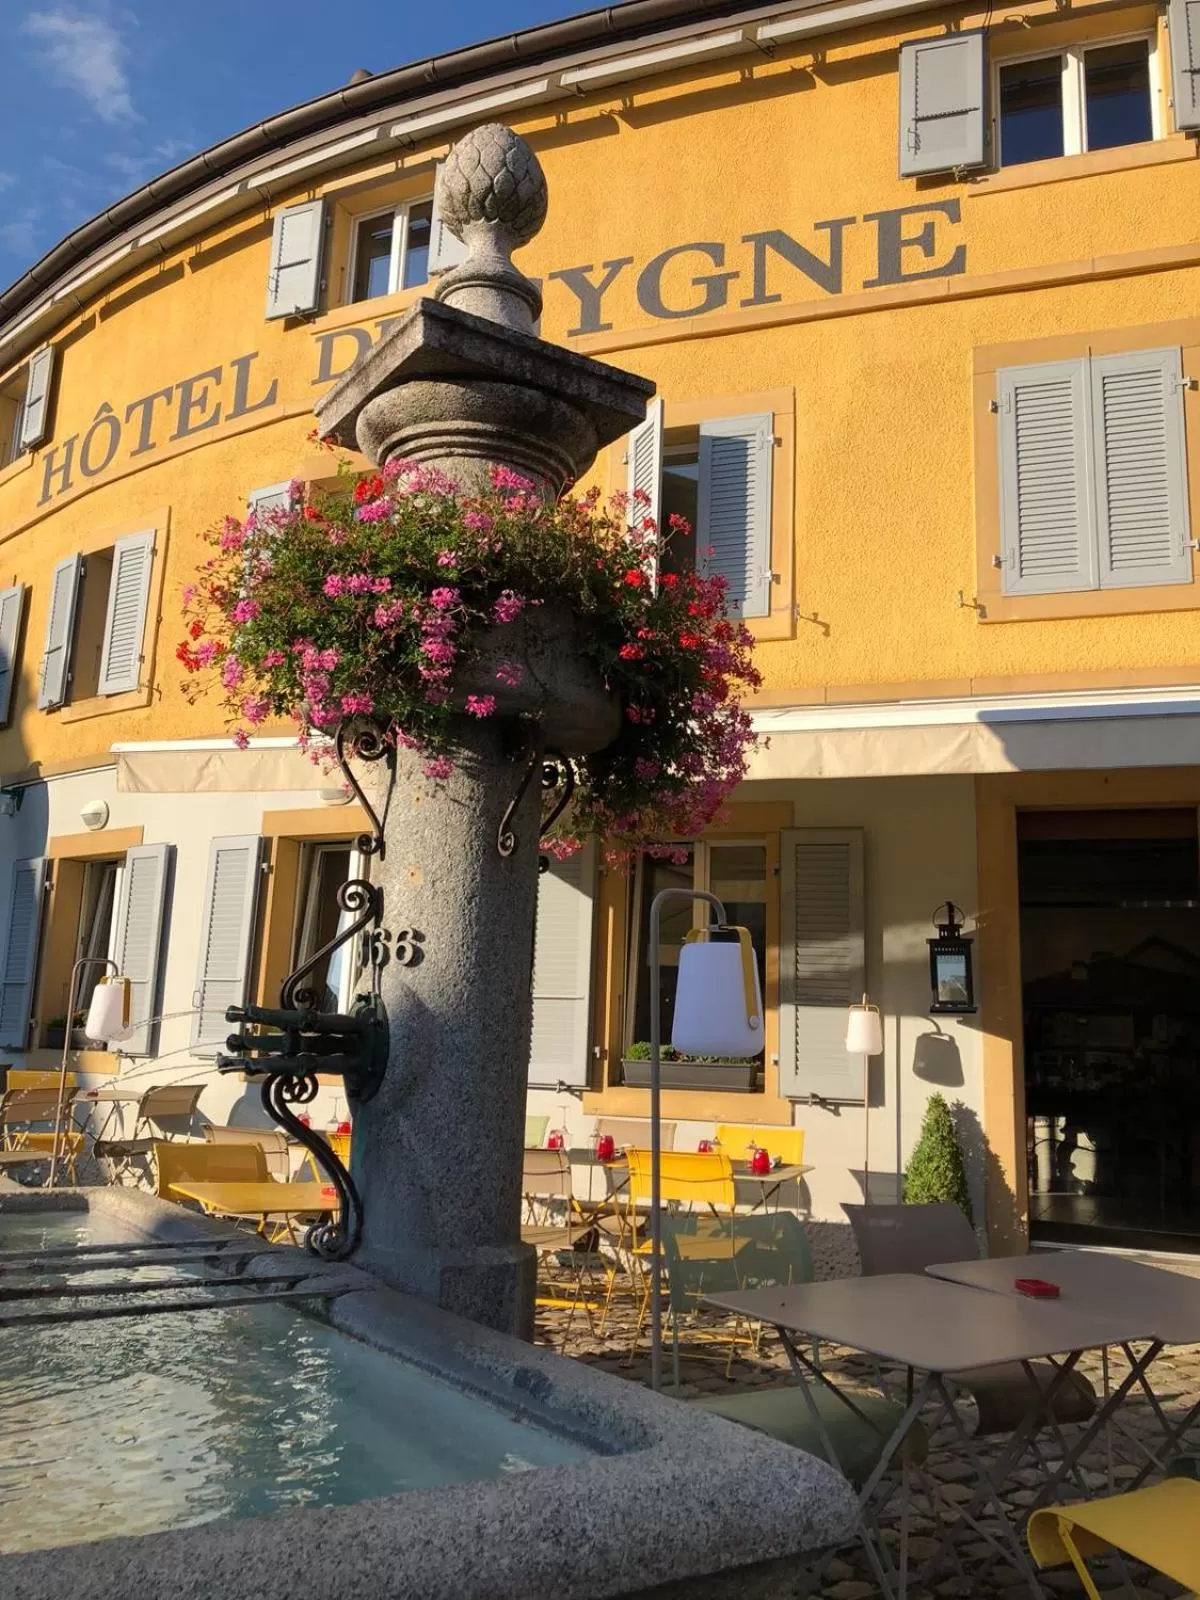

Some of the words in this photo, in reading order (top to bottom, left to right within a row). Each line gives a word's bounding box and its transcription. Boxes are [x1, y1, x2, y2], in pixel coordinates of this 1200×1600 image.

[36, 351, 279, 508] HÔTEL
[310, 314, 405, 386] D
[526, 197, 967, 338] YGNE
